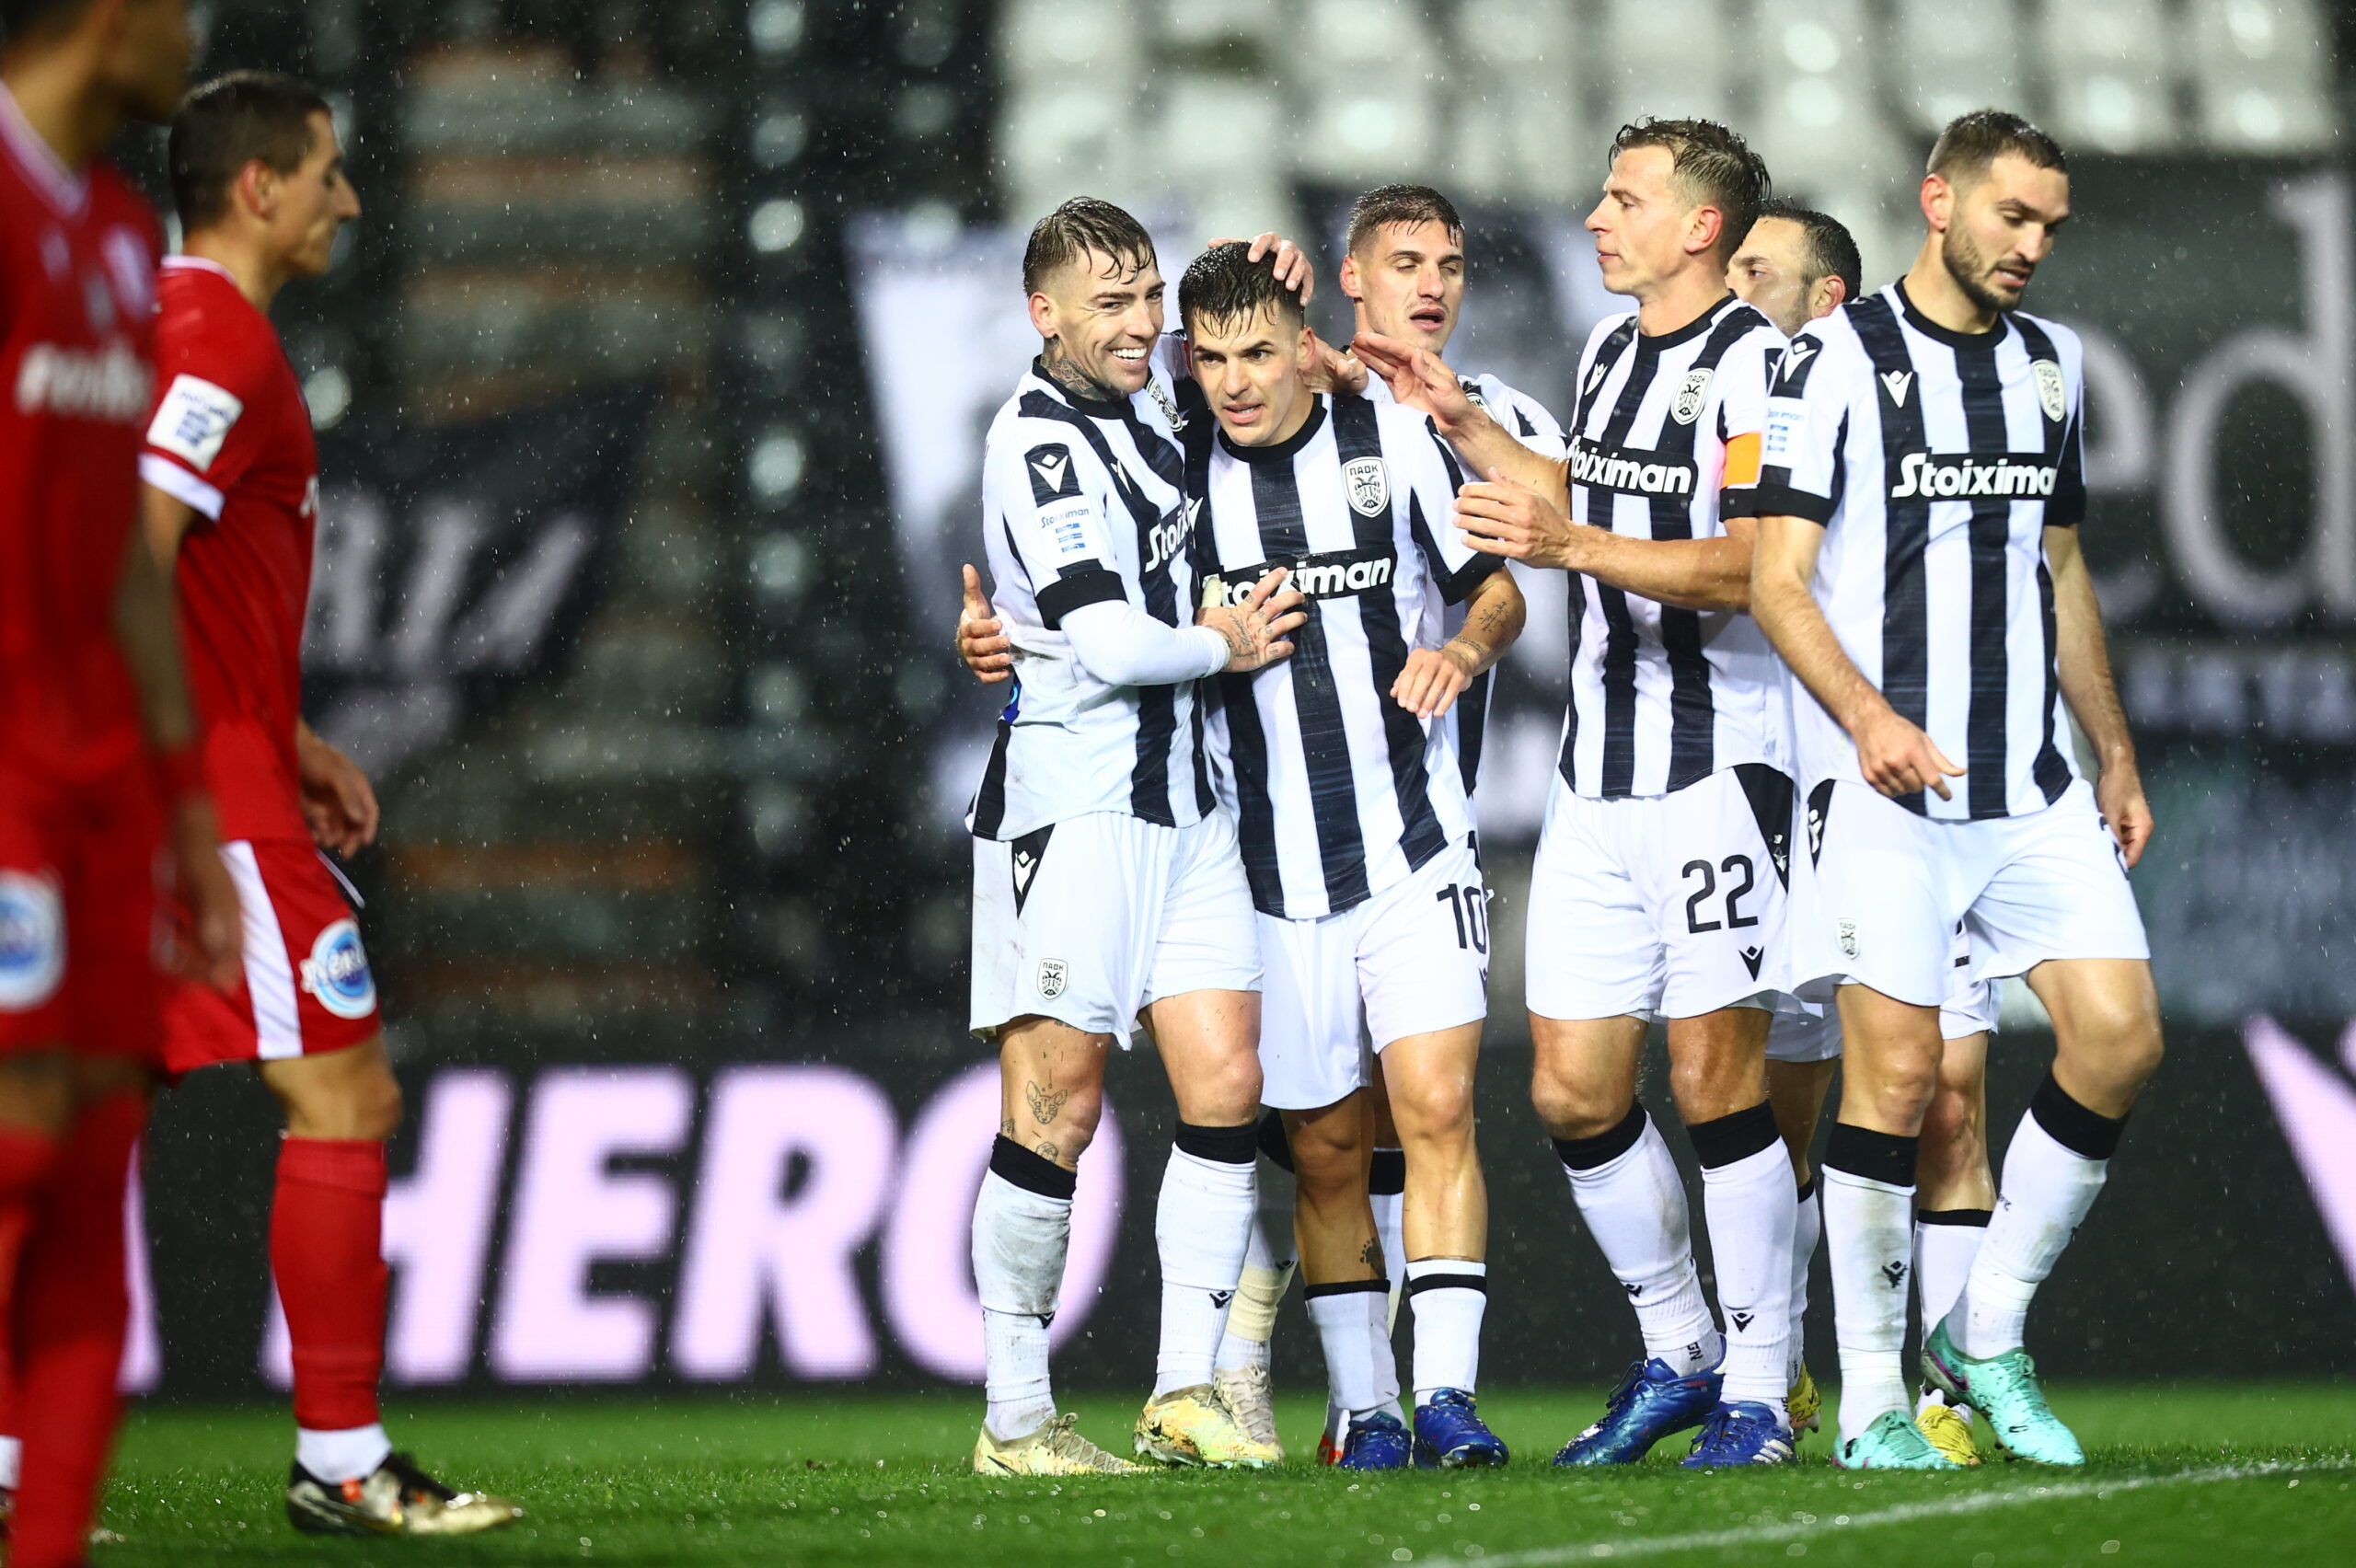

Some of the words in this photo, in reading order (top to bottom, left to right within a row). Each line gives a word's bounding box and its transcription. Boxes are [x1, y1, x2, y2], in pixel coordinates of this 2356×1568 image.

[1571, 435, 1692, 494] toiximan
[1891, 453, 2058, 499] Stoixima
[1436, 883, 1486, 955] 10
[1681, 854, 1759, 934] 22
[261, 1064, 1126, 1387] HERO
